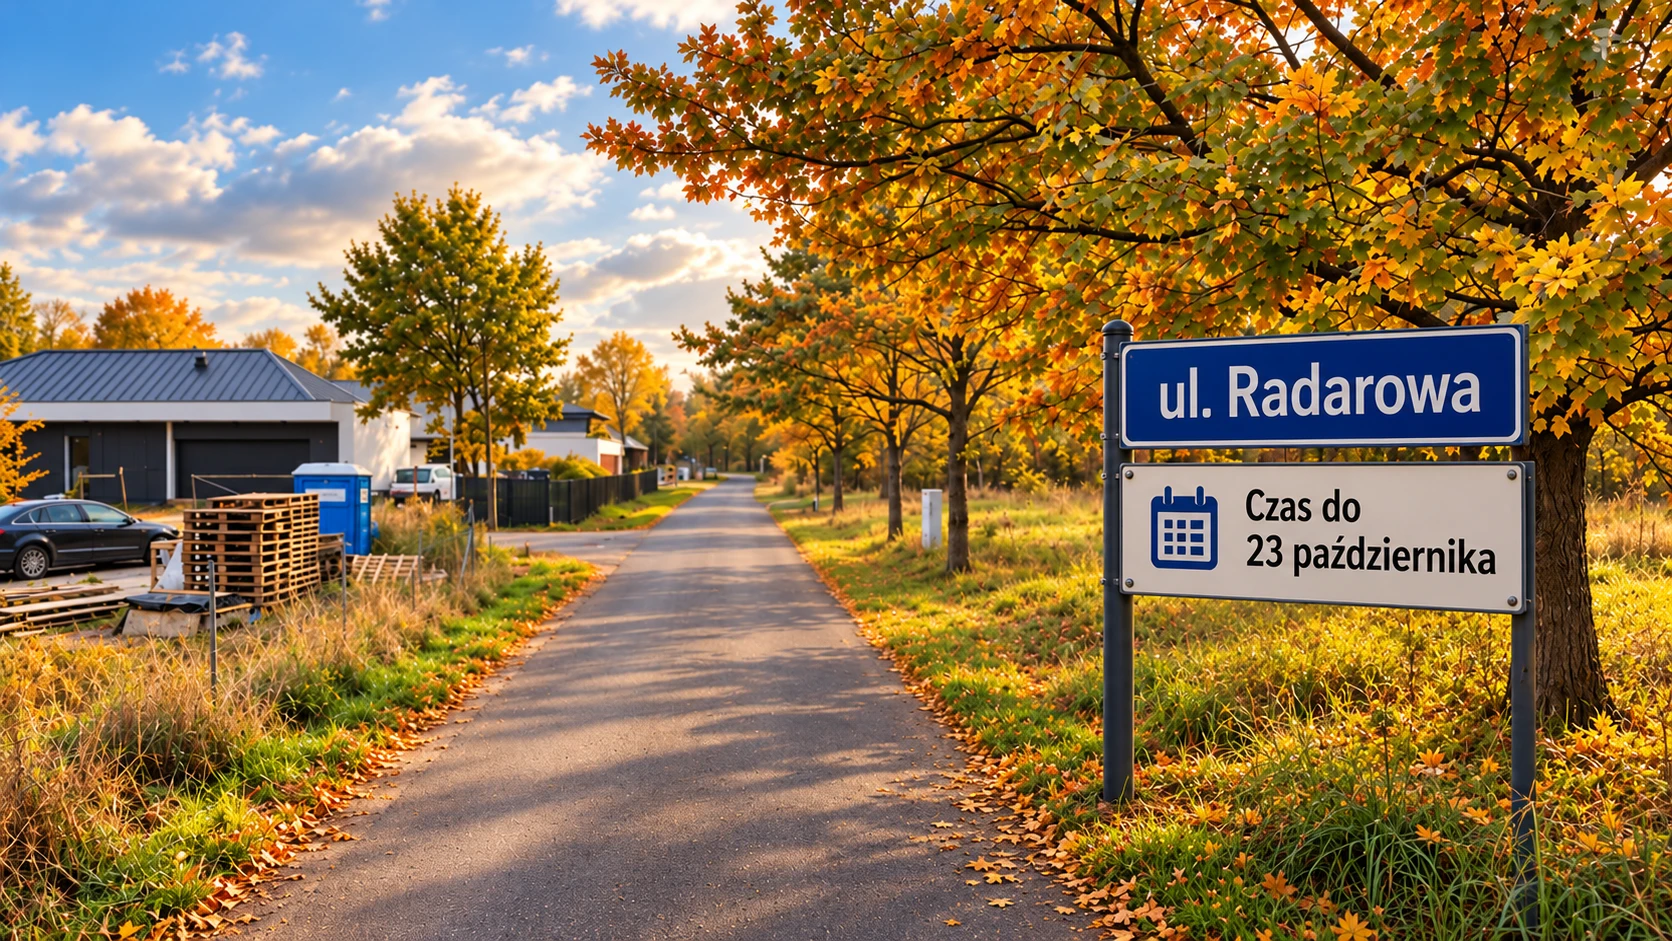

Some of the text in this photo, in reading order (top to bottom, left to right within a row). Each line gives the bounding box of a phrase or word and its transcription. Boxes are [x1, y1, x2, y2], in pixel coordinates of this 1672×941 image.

[1160, 361, 1481, 419] ul. Radarowa
[1245, 488, 1361, 523] Czas do
[1246, 534, 1497, 577] 23 października
